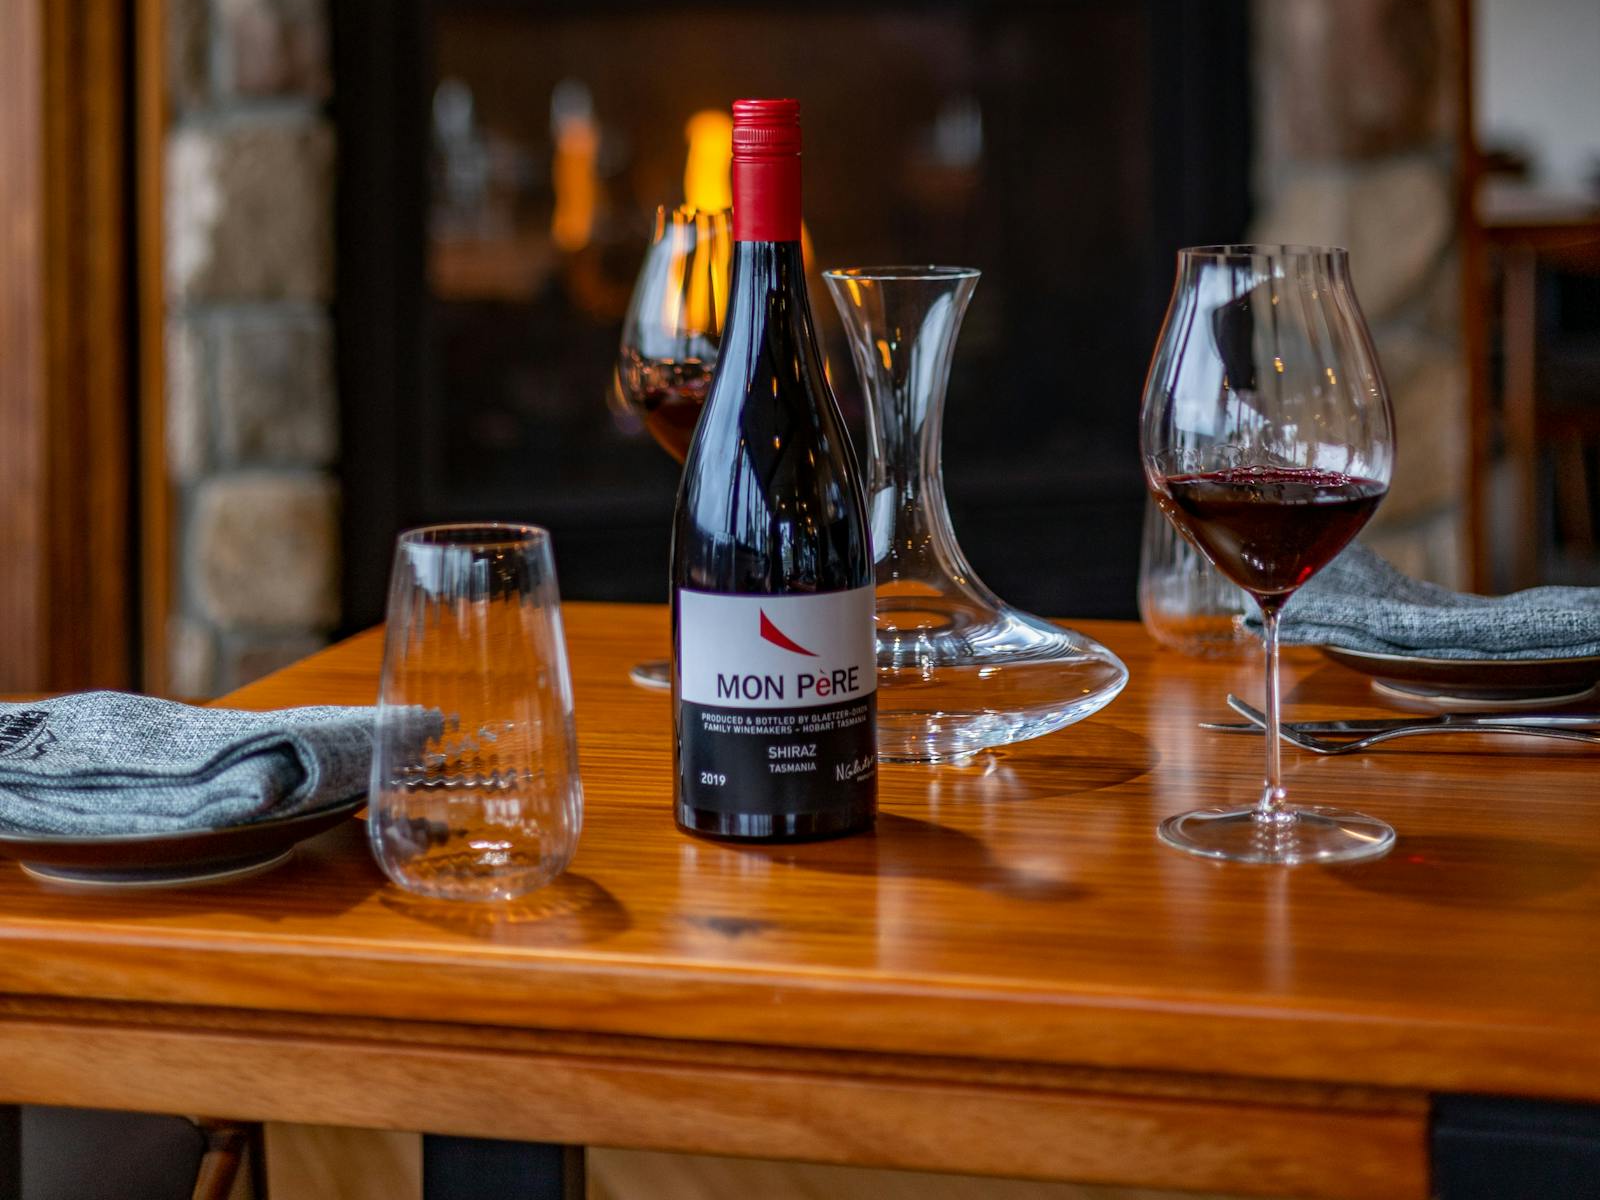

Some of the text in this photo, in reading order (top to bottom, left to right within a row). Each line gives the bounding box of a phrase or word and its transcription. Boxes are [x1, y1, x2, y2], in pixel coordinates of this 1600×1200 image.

[717, 673, 784, 700] MON
[701, 712, 743, 725] PRODUCED
[746, 716, 752, 725] &
[755, 716, 795, 726] BOTTLED
[798, 715, 809, 724] BY
[704, 722, 731, 733] FAMILY
[733, 725, 792, 735] WINEMAKERS
[802, 721, 834, 733] HOBART
[837, 715, 867, 728] TASMANIA
[768, 744, 817, 759] SHIRAZ
[769, 762, 817, 774] TASMANIA
[701, 772, 727, 786] 2019
